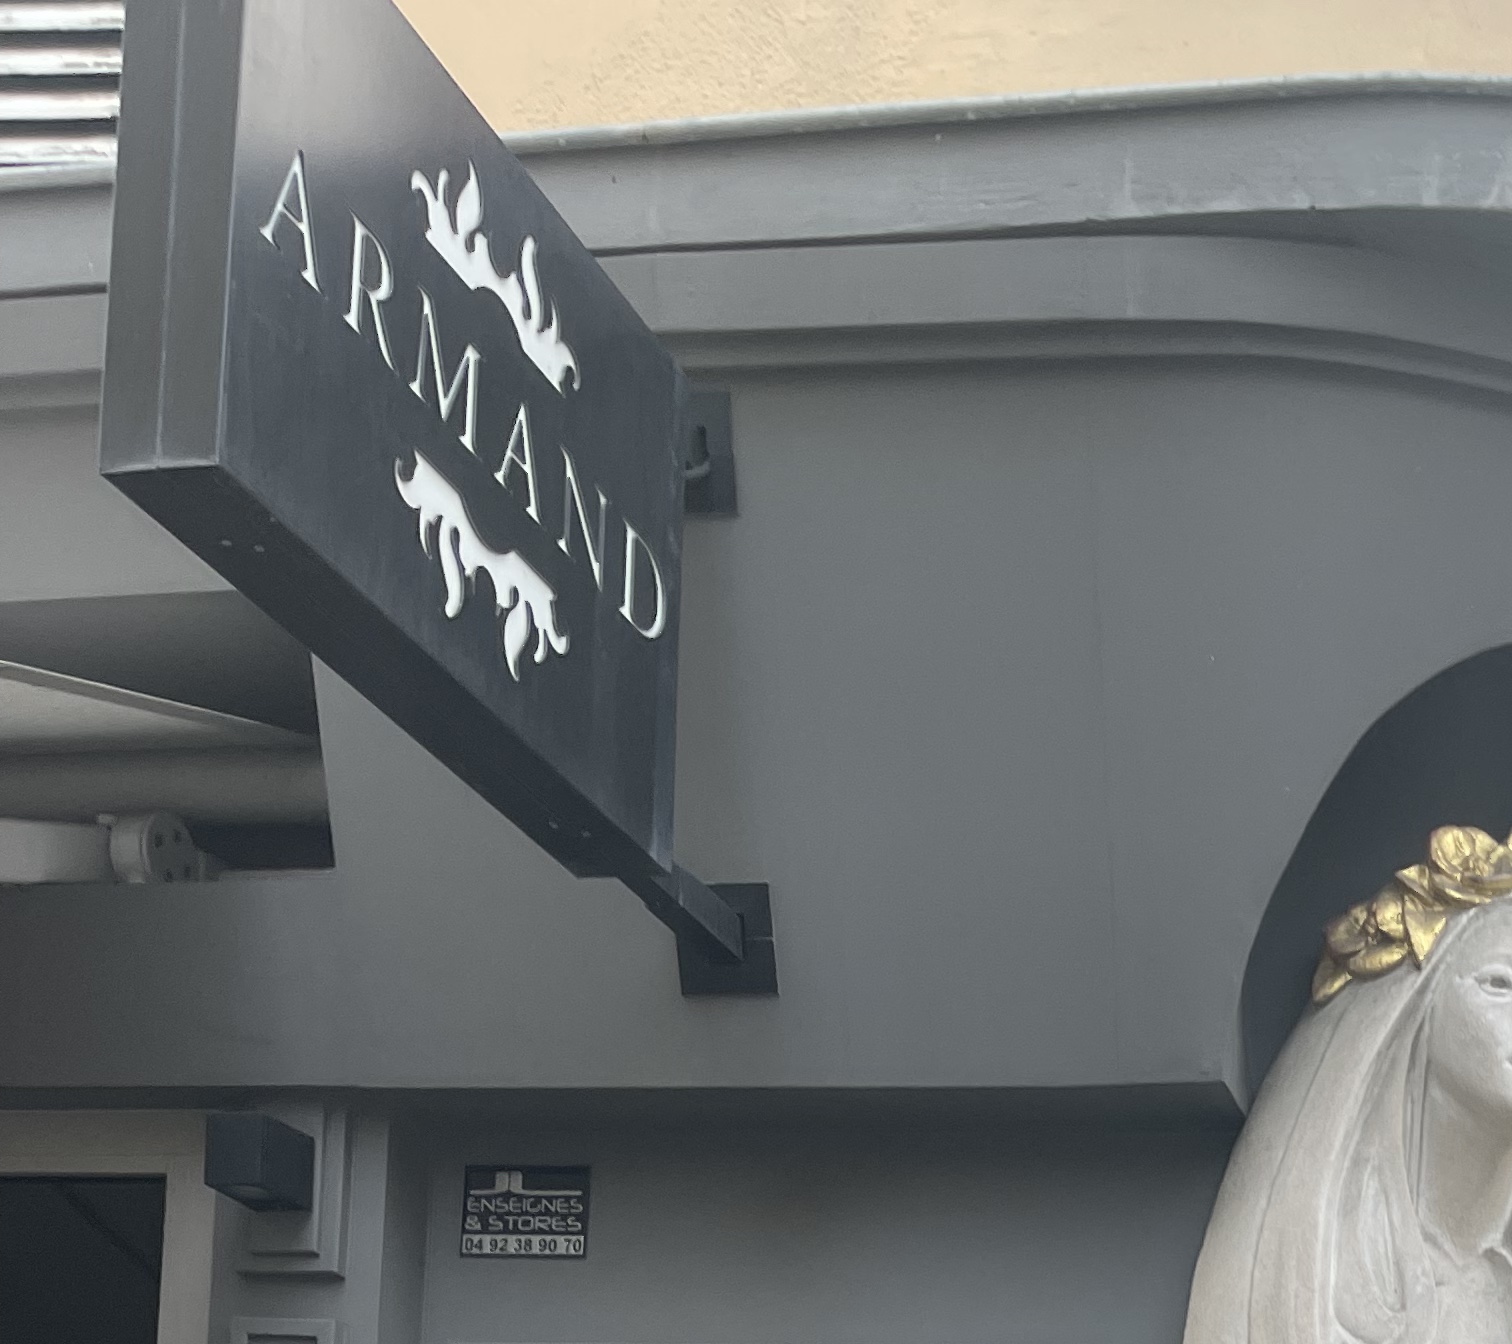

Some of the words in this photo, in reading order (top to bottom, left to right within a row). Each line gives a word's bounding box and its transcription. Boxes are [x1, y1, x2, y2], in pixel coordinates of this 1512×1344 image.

[258, 149, 667, 642] ARMAND
[467, 1197, 584, 1213] ENSEIGNES
[464, 1215, 482, 1231] &
[488, 1215, 582, 1232] STORES
[464, 1237, 483, 1251] 04
[489, 1237, 508, 1252] 92
[513, 1237, 533, 1252] 38
[538, 1238, 558, 1253] 90
[563, 1239, 582, 1253] 70
